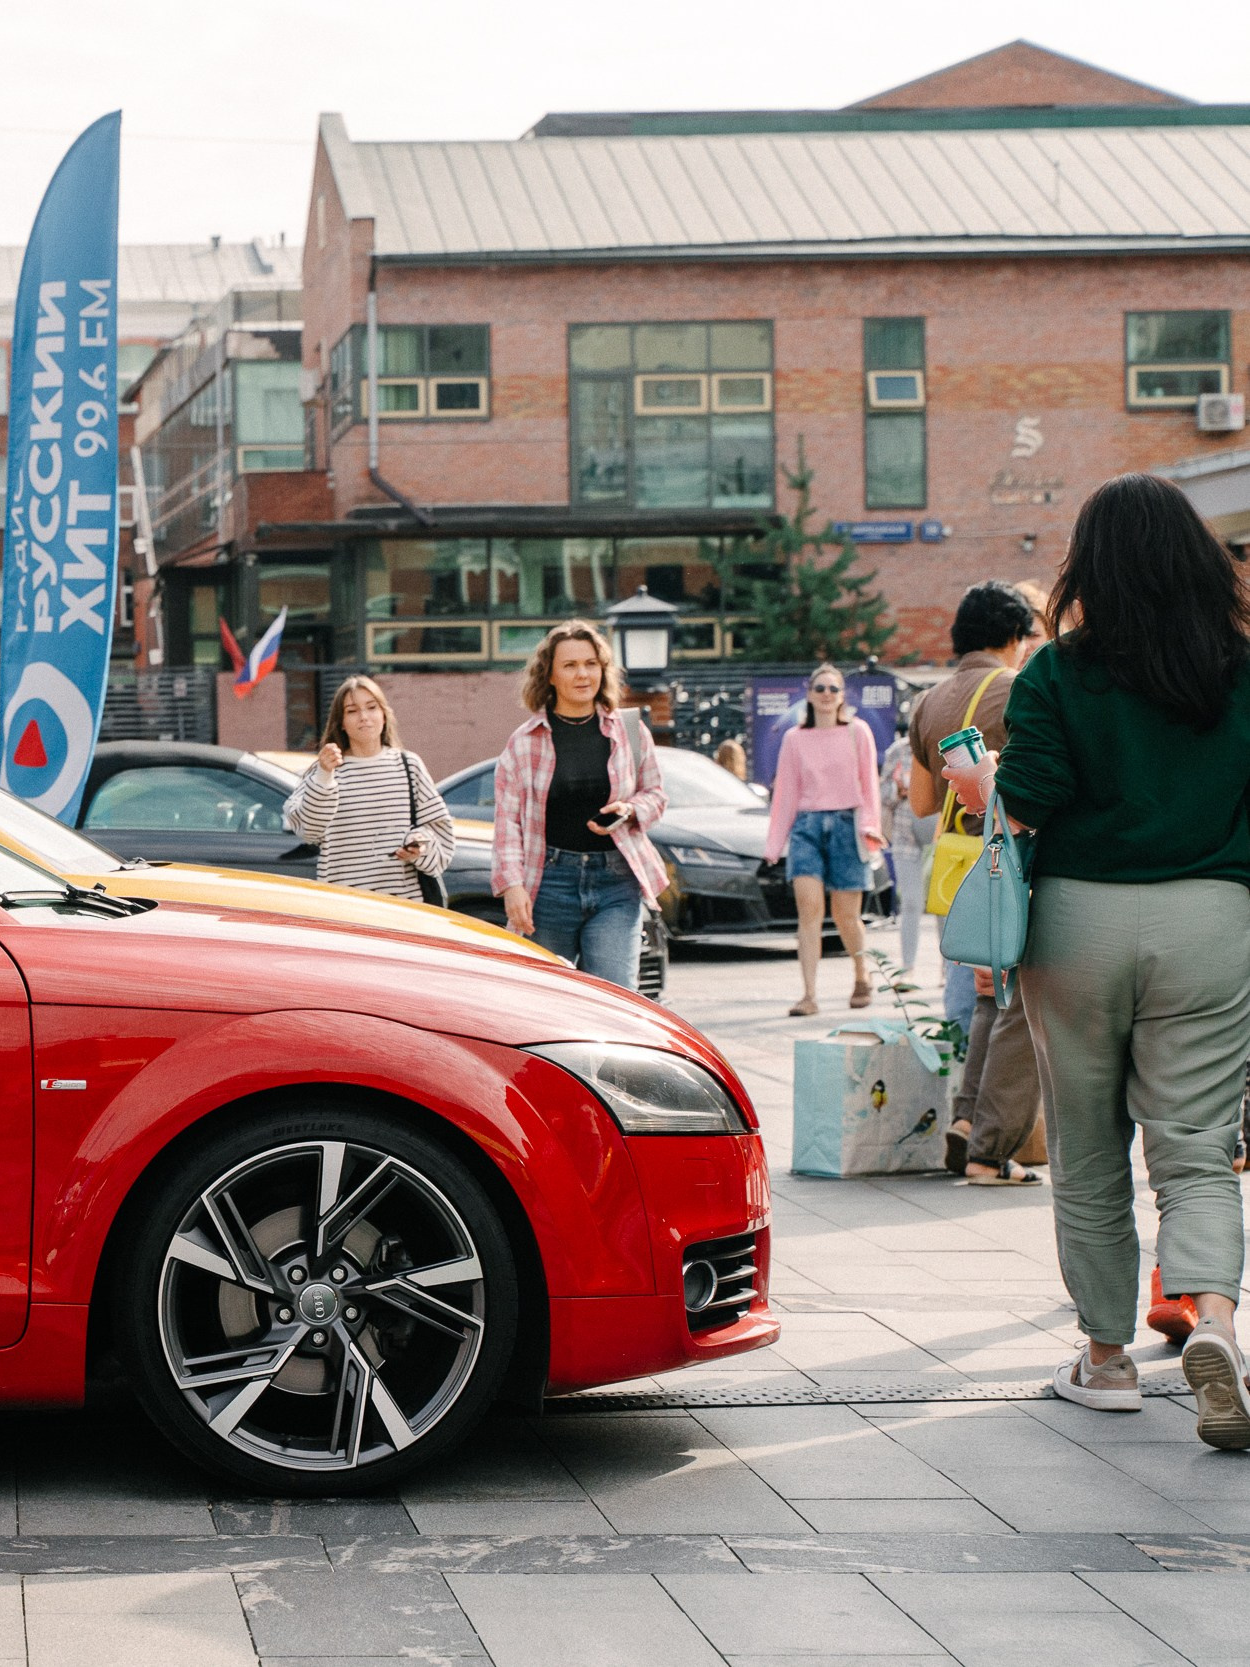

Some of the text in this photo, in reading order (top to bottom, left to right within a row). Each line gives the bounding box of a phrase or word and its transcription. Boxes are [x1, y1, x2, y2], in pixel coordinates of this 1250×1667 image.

[78, 279, 111, 348] FM
[28, 281, 66, 633] РУССКИЙ
[59, 479, 111, 636] ХИТ
